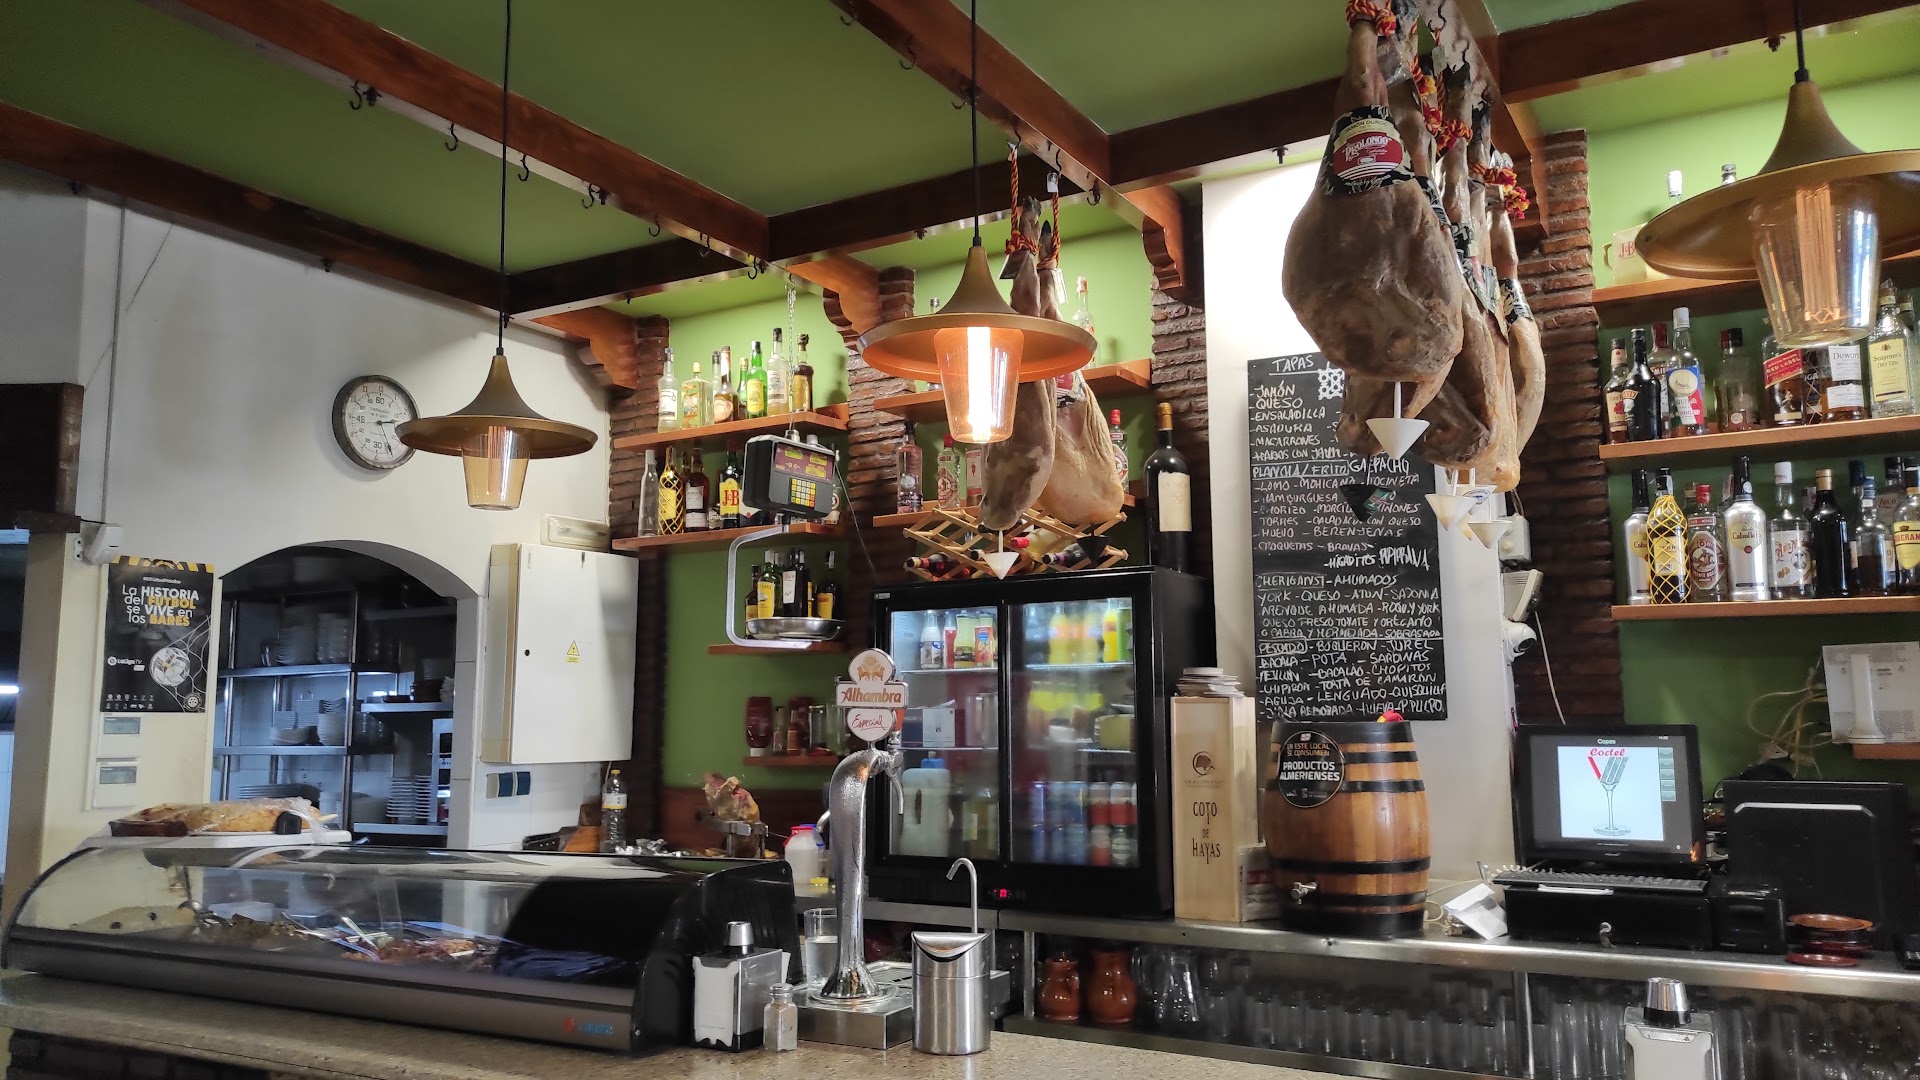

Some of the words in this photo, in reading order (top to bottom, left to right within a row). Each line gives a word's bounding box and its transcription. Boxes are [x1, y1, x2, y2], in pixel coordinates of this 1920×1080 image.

[1342, 136, 1392, 162] PROLONGO
[1272, 355, 1314, 372] TAPAS
[1780, 357, 1800, 368] LABEL
[376, 396, 385, 404] 60
[1256, 397, 1303, 409] QUESO
[1255, 406, 1325, 421] ENSALADILLA
[1256, 423, 1312, 434] ASADURA
[1292, 448, 1308, 458] CON
[1260, 481, 1290, 491] LOMO
[722, 490, 739, 506] J&B
[1388, 516, 1421, 526] QUESO
[1262, 528, 1294, 538] HUEVO
[1334, 574, 1399, 589] AHUMADOS
[122, 584, 137, 595] La
[142, 586, 199, 600] HISTORIA
[1257, 590, 1291, 606] YORK
[1301, 590, 1340, 601] QUESO
[124, 594, 145, 605] del
[127, 605, 140, 614] se
[144, 604, 174, 616] VIVE
[177, 608, 193, 618] en
[128, 612, 146, 624] los
[150, 614, 190, 626] BARES
[1263, 618, 1296, 627] QUESO
[1374, 618, 1378, 626] Y
[1308, 629, 1313, 638] Y
[1386, 639, 1433, 652] JUREL
[1312, 652, 1347, 669] POTA
[1370, 650, 1429, 664] SARDINAS
[1372, 663, 1431, 675] CHOPITOS
[1356, 677, 1371, 686] DE
[841, 688, 901, 704] Alhambra
[1318, 687, 1387, 701] LENGUADO
[852, 714, 886, 730] Especial
[1590, 748, 1626, 756] Coctel
[1283, 762, 1335, 771] PRODUCTOS
[1280, 772, 1340, 781] ALMERIENSES
[1193, 802, 1218, 824] COTO
[1202, 828, 1209, 838] DE
[1192, 838, 1221, 864] HAYAS
